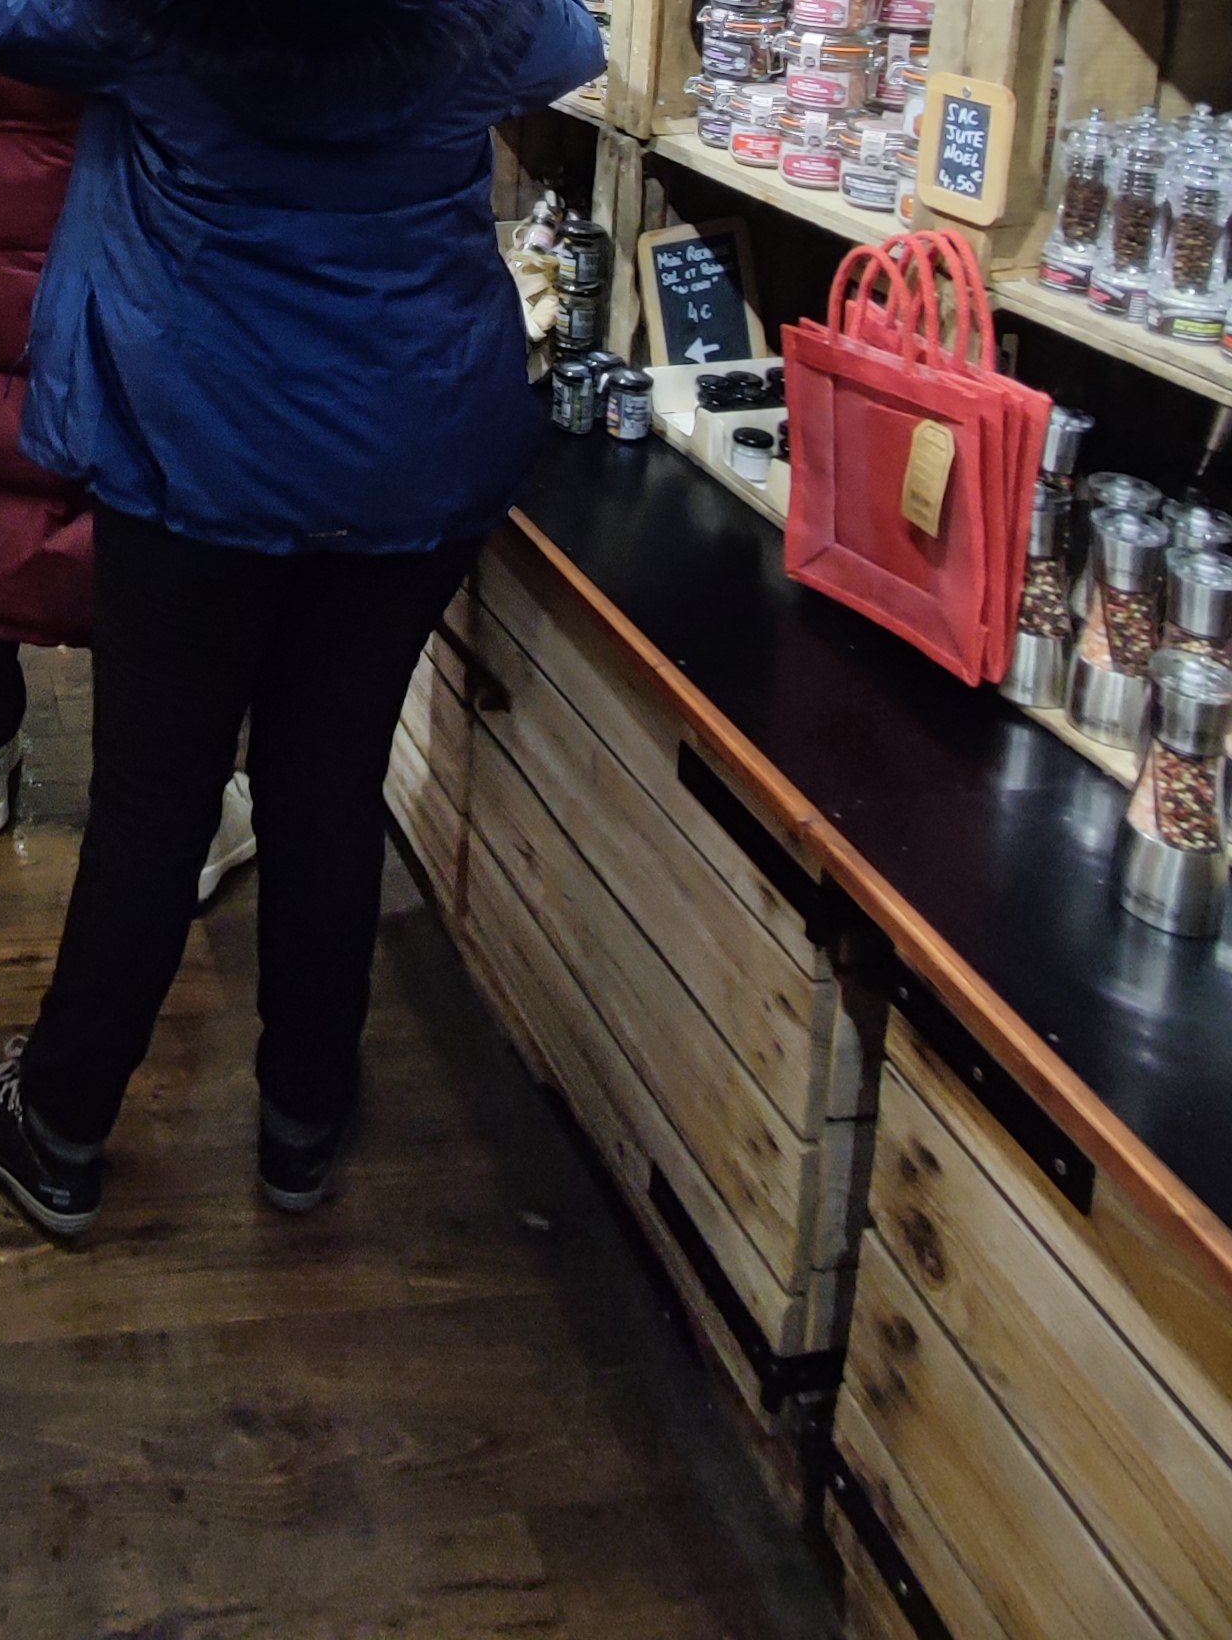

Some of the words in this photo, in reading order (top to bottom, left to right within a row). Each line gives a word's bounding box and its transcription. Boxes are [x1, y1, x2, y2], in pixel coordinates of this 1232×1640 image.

[946, 103, 979, 125] SAC
[945, 124, 985, 148] JUTE
[943, 144, 980, 167] NOËL
